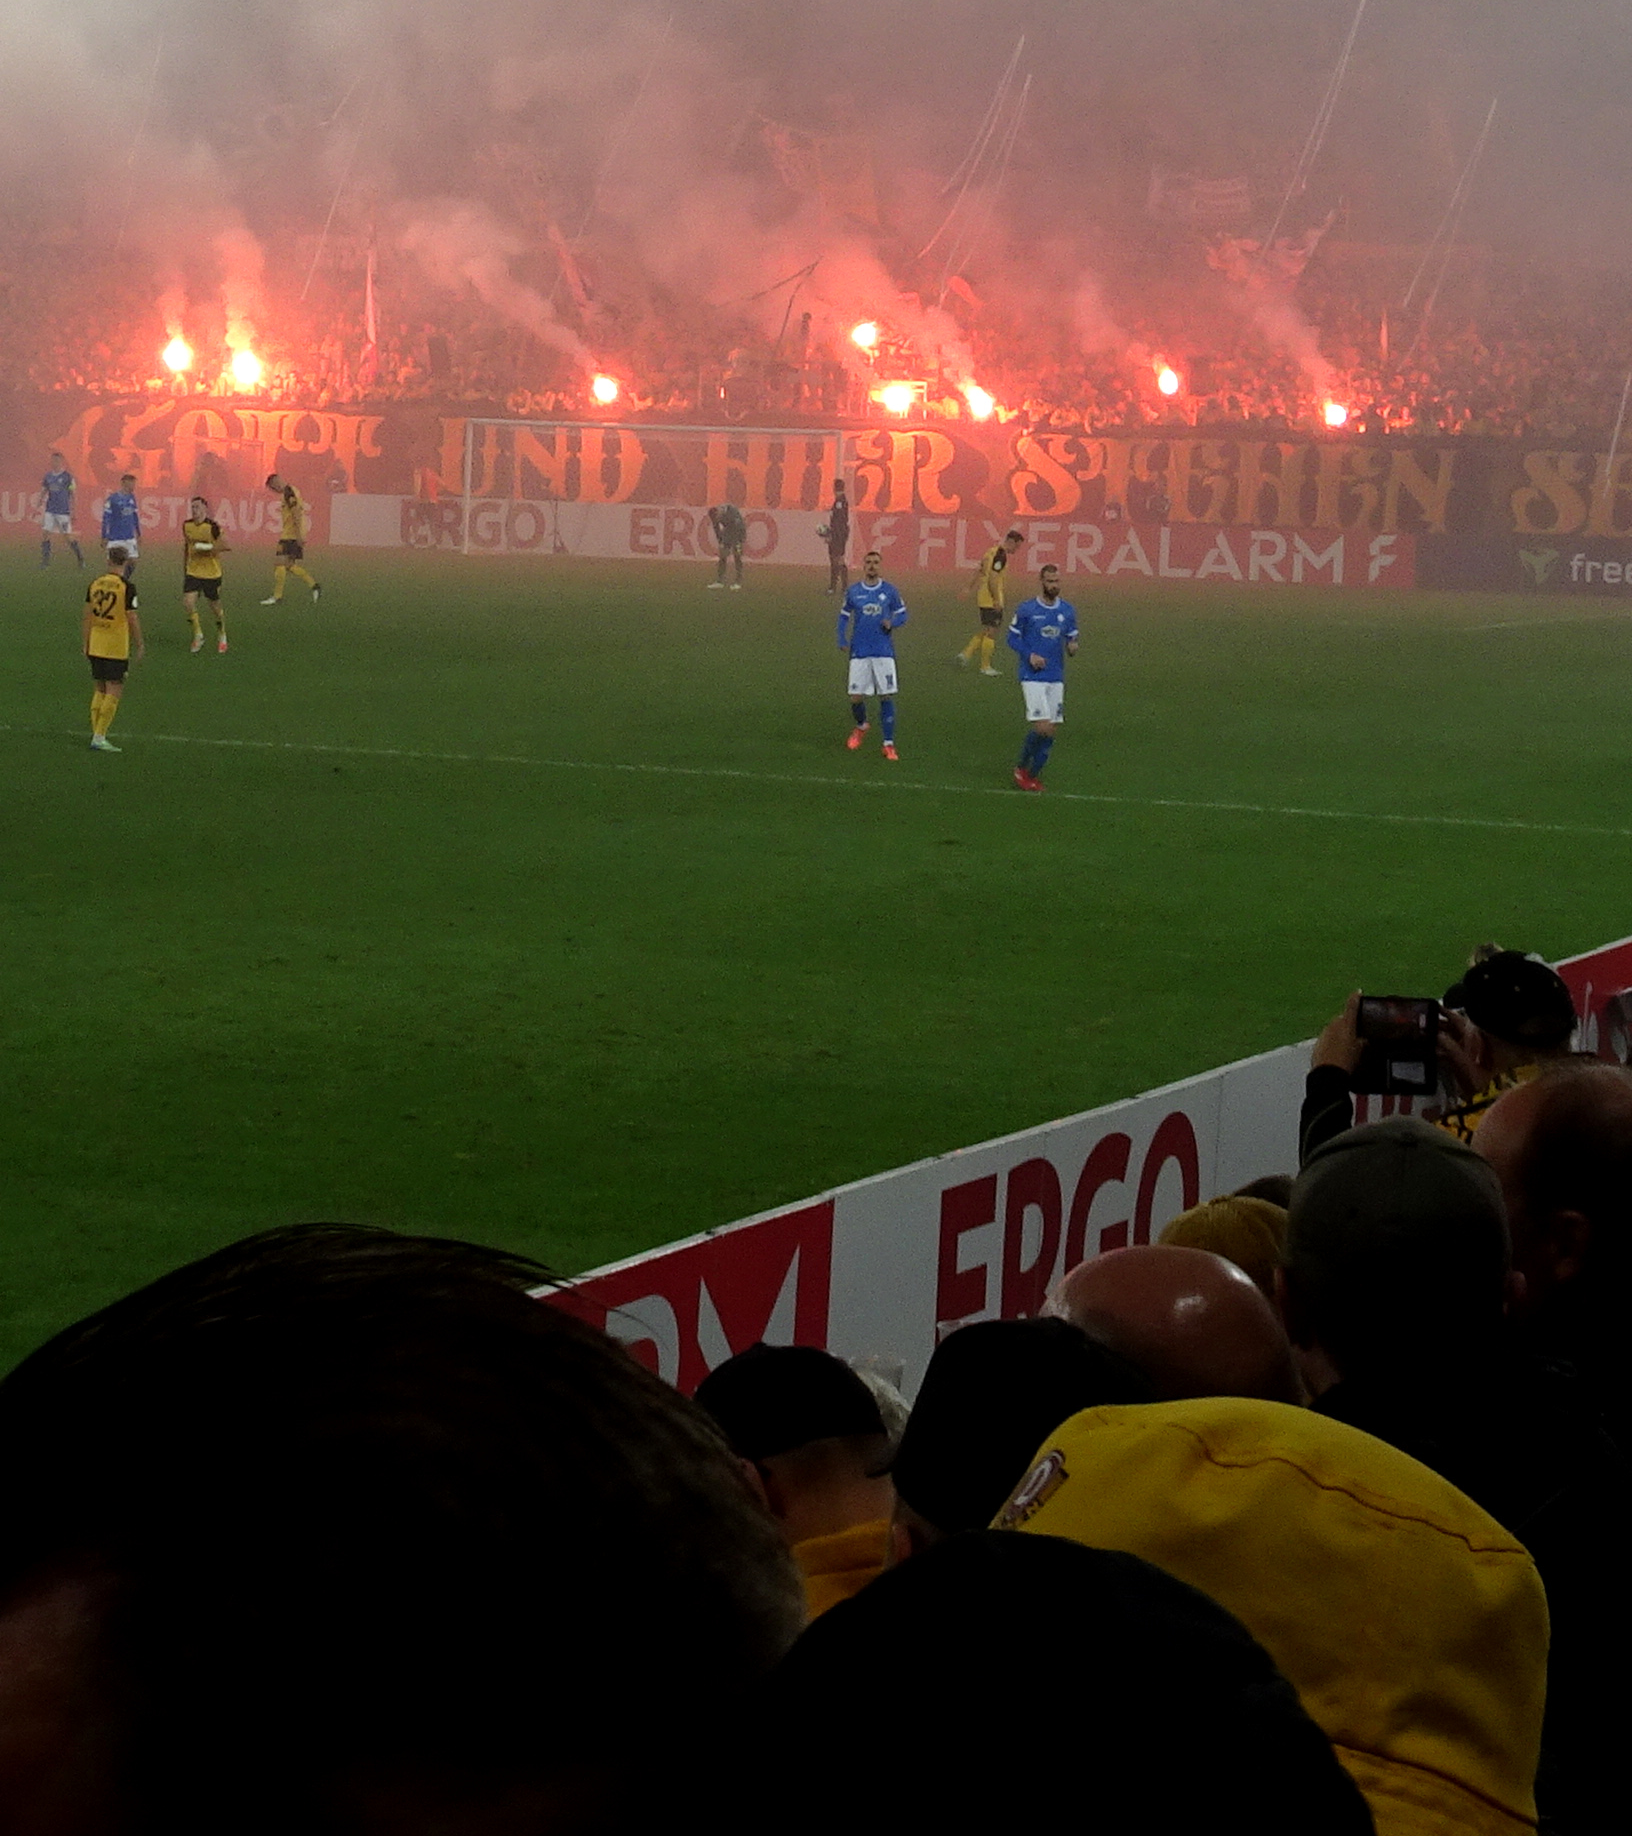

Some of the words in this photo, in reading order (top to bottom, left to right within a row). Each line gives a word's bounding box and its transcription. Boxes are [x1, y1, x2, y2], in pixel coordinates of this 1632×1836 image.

[50, 399, 385, 494] GOTT
[437, 416, 648, 503] UND
[704, 428, 961, 515] HIER
[1009, 430, 1459, 534] STEHEN
[92, 588, 118, 621] 32
[935, 1111, 1200, 1342] ERGO
